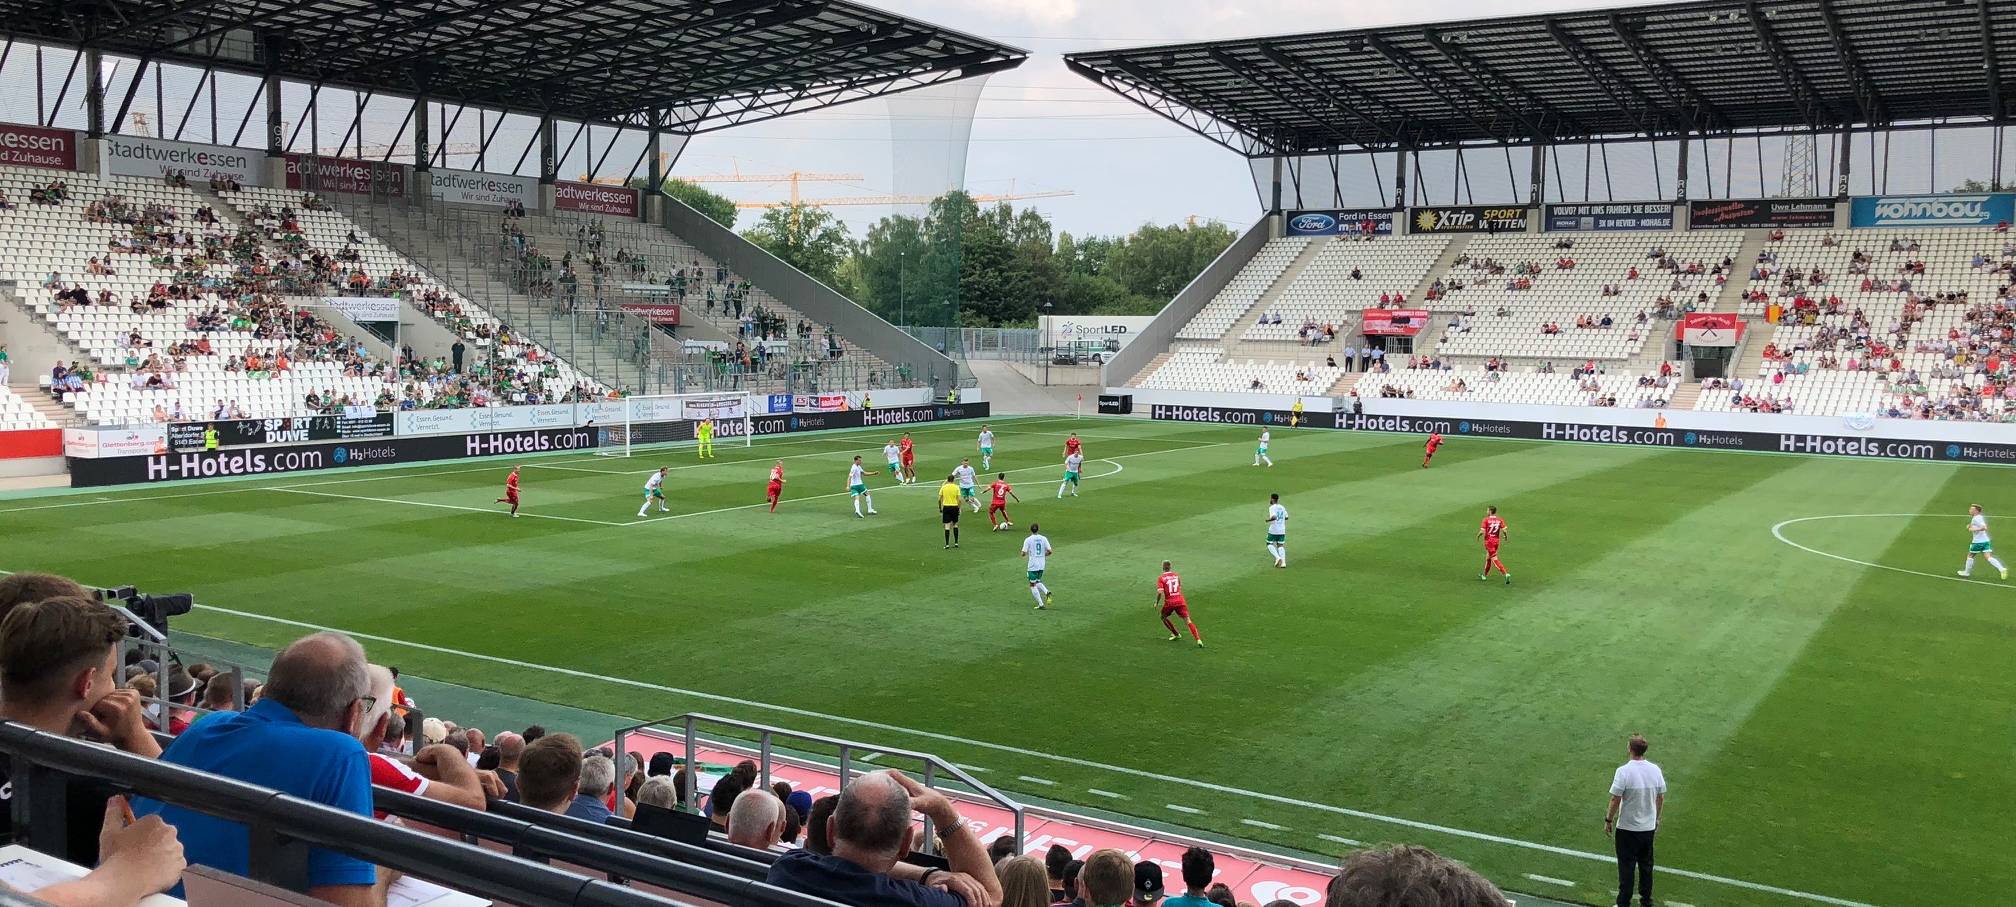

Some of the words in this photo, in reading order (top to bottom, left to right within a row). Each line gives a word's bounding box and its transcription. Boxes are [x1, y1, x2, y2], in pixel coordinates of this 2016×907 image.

[11, 150, 65, 166] Zuhause.
[107, 138, 248, 169] Stadtwerkessen
[1338, 212, 1357, 221] Ford
[1358, 212, 1367, 220] in
[1367, 211, 1393, 220] Essen
[1483, 208, 1523, 219] SPORT
[1553, 205, 1577, 216] VOLVO?
[1298, 216, 1326, 230] Ford
[1478, 218, 1528, 229] WTTEN
[1075, 323, 1128, 338] SportLED
[863, 407, 934, 426] H-Hotels.com
[1154, 404, 1256, 424] H-Hotels.com
[1334, 413, 1451, 434] H-Hotels.com
[265, 429, 310, 444] DUWE
[1541, 423, 1675, 446] H-Hotels.com
[465, 431, 590, 456] H-Hotels.com
[1779, 433, 1935, 459] H-Hotels.com
[147, 448, 323, 481] H-Hotels.com
[1035, 542, 1042, 556] 9
